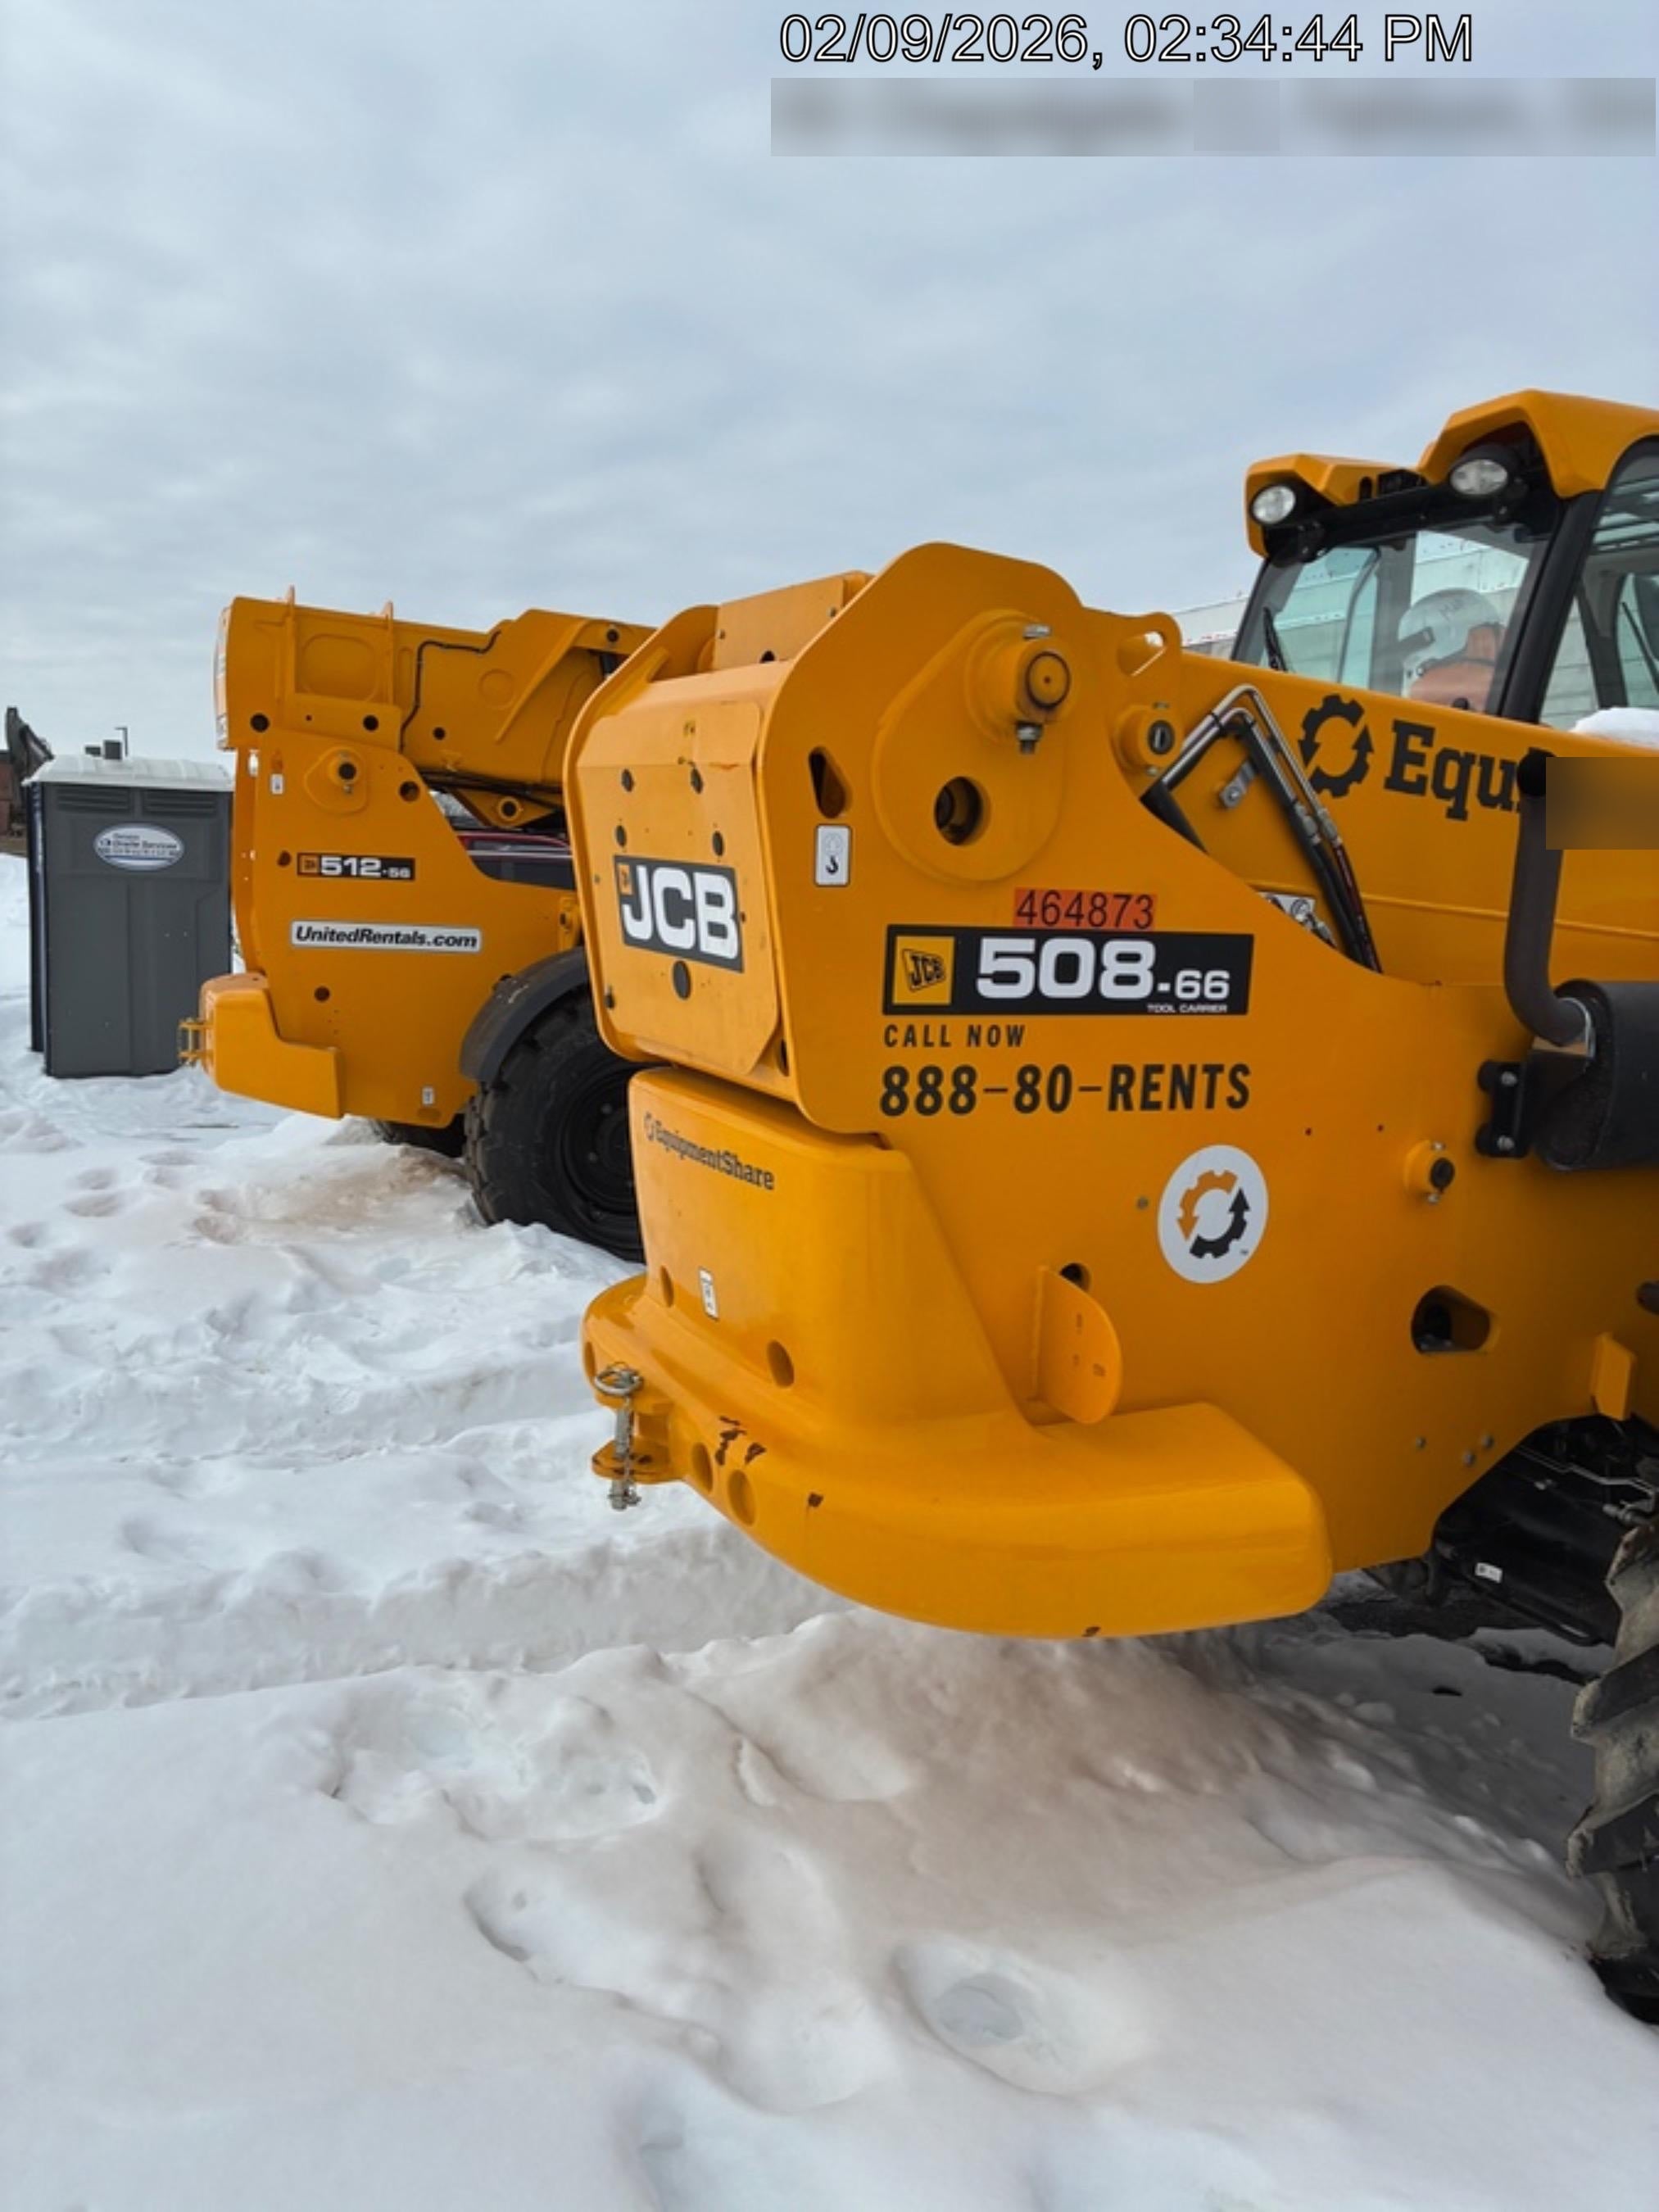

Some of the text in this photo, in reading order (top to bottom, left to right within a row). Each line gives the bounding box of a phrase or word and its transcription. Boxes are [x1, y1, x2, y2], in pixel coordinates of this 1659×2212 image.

[622, 864, 739, 959] JCB
[1016, 890, 1154, 929] 464873
[295, 926, 478, 948] UnitedRentals.com
[976, 937, 1231, 999] 508-66
[1147, 1004, 1227, 1013] TOOL CARRIER
[884, 1024, 1026, 1048] CALL NOW
[880, 1063, 1251, 1117] 888-80-RENTS
[655, 1126, 774, 1190] EquipmentShare
